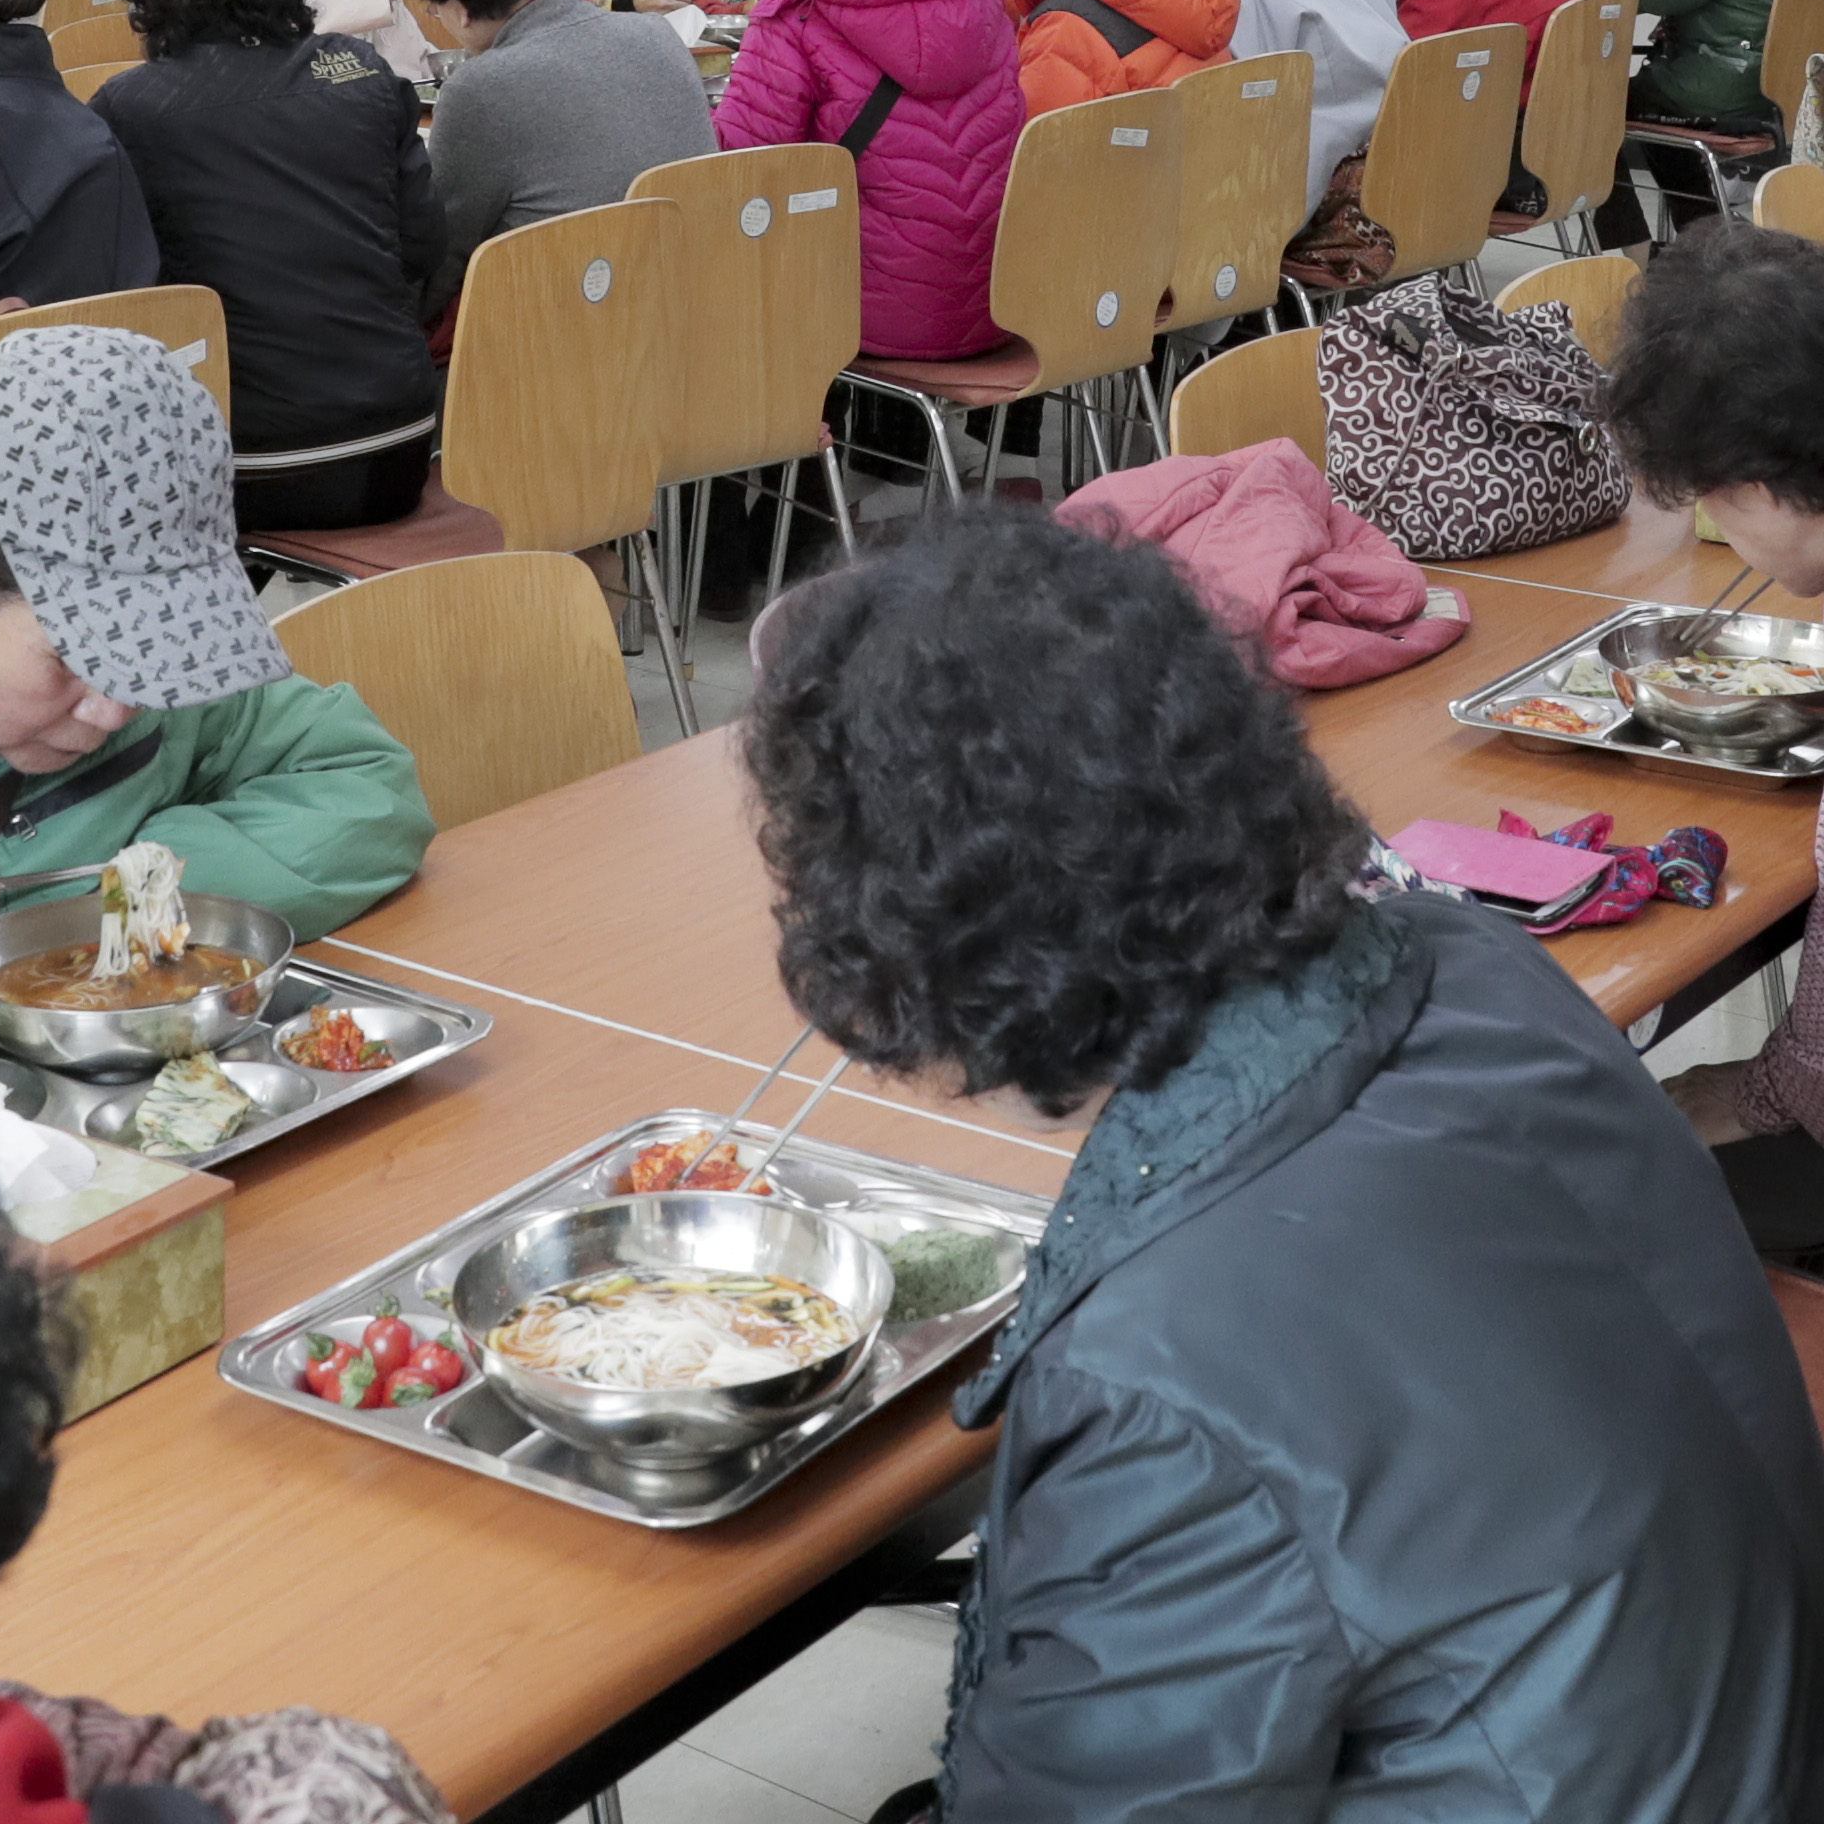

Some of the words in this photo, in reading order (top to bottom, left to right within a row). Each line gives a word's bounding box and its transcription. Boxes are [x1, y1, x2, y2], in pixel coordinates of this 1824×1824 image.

[317, 48, 355, 64] TEAM
[311, 59, 361, 77] SPIRIT
[79, 408, 104, 417] FILA
[150, 427, 172, 442] FILA
[55, 440, 80, 455] FILA
[29, 450, 43, 474] FILA
[137, 498, 160, 512] FILA
[140, 580, 163, 597] FILA
[88, 598, 112, 616] FILA
[110, 650, 134, 667] FILA
[187, 680, 212, 696] FILA
